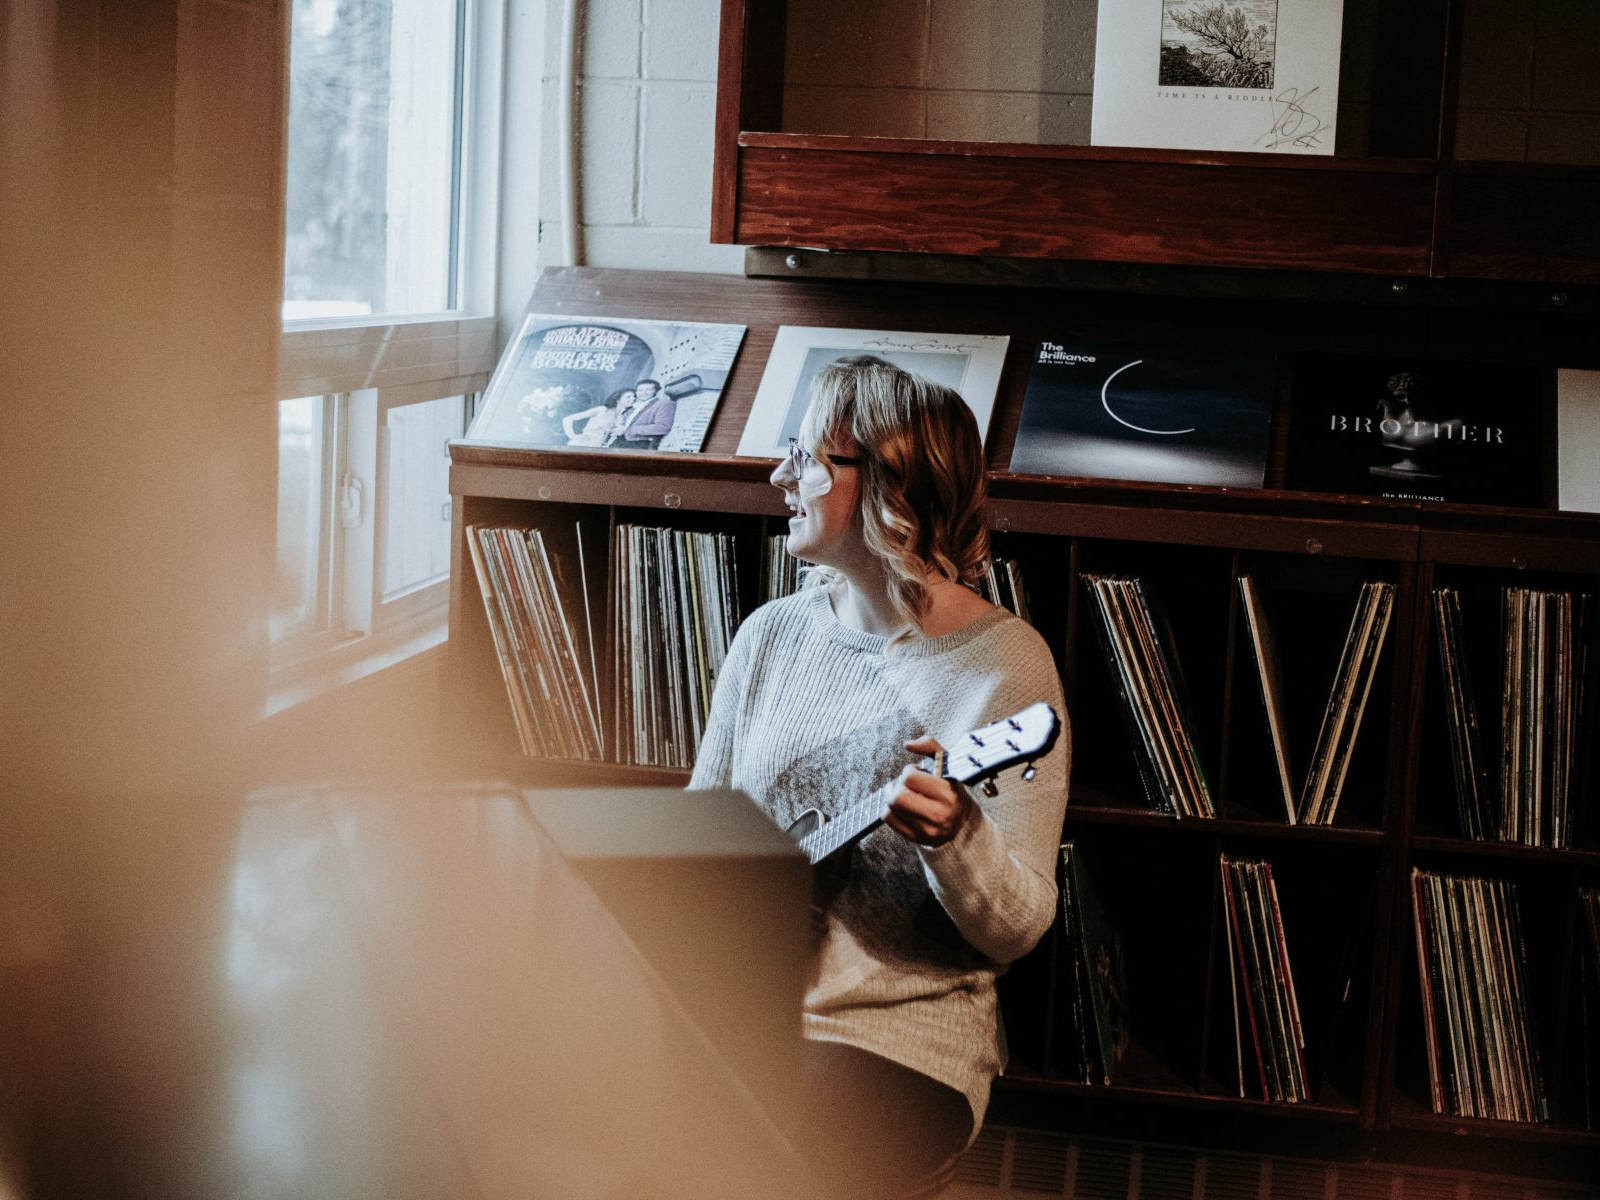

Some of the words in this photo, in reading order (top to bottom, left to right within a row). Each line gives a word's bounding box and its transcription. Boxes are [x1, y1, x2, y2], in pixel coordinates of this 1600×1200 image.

[1228, 94, 1274, 102] RIDDLE
[1041, 342, 1064, 351] The
[1040, 350, 1096, 363] Brilliance
[530, 359, 616, 371] BORDER
[1330, 414, 1504, 444] BROTHER
[1397, 493, 1445, 502] BRILLIANCE
